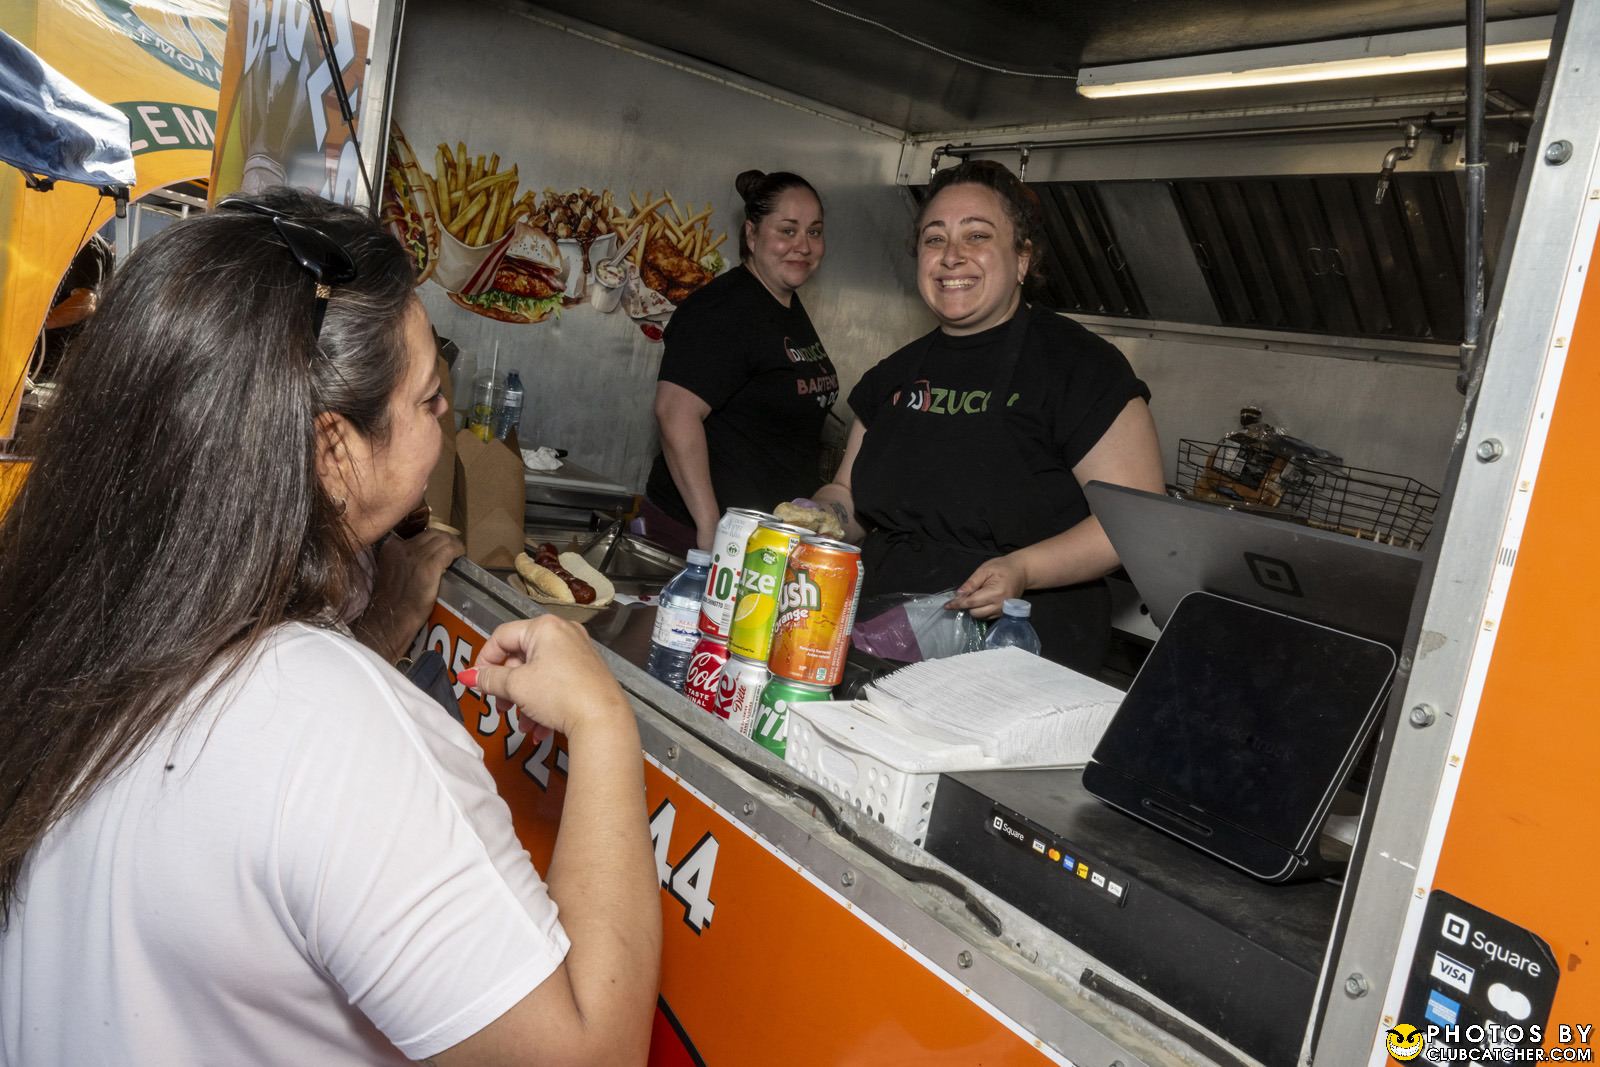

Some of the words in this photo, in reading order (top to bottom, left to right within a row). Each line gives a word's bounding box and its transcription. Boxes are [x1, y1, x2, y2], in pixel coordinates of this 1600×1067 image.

[780, 573, 818, 612] ush
[688, 687, 710, 701] TASTE
[1002, 823, 1025, 841] Square
[1471, 931, 1541, 977] Square
[1439, 960, 1467, 984] VISA
